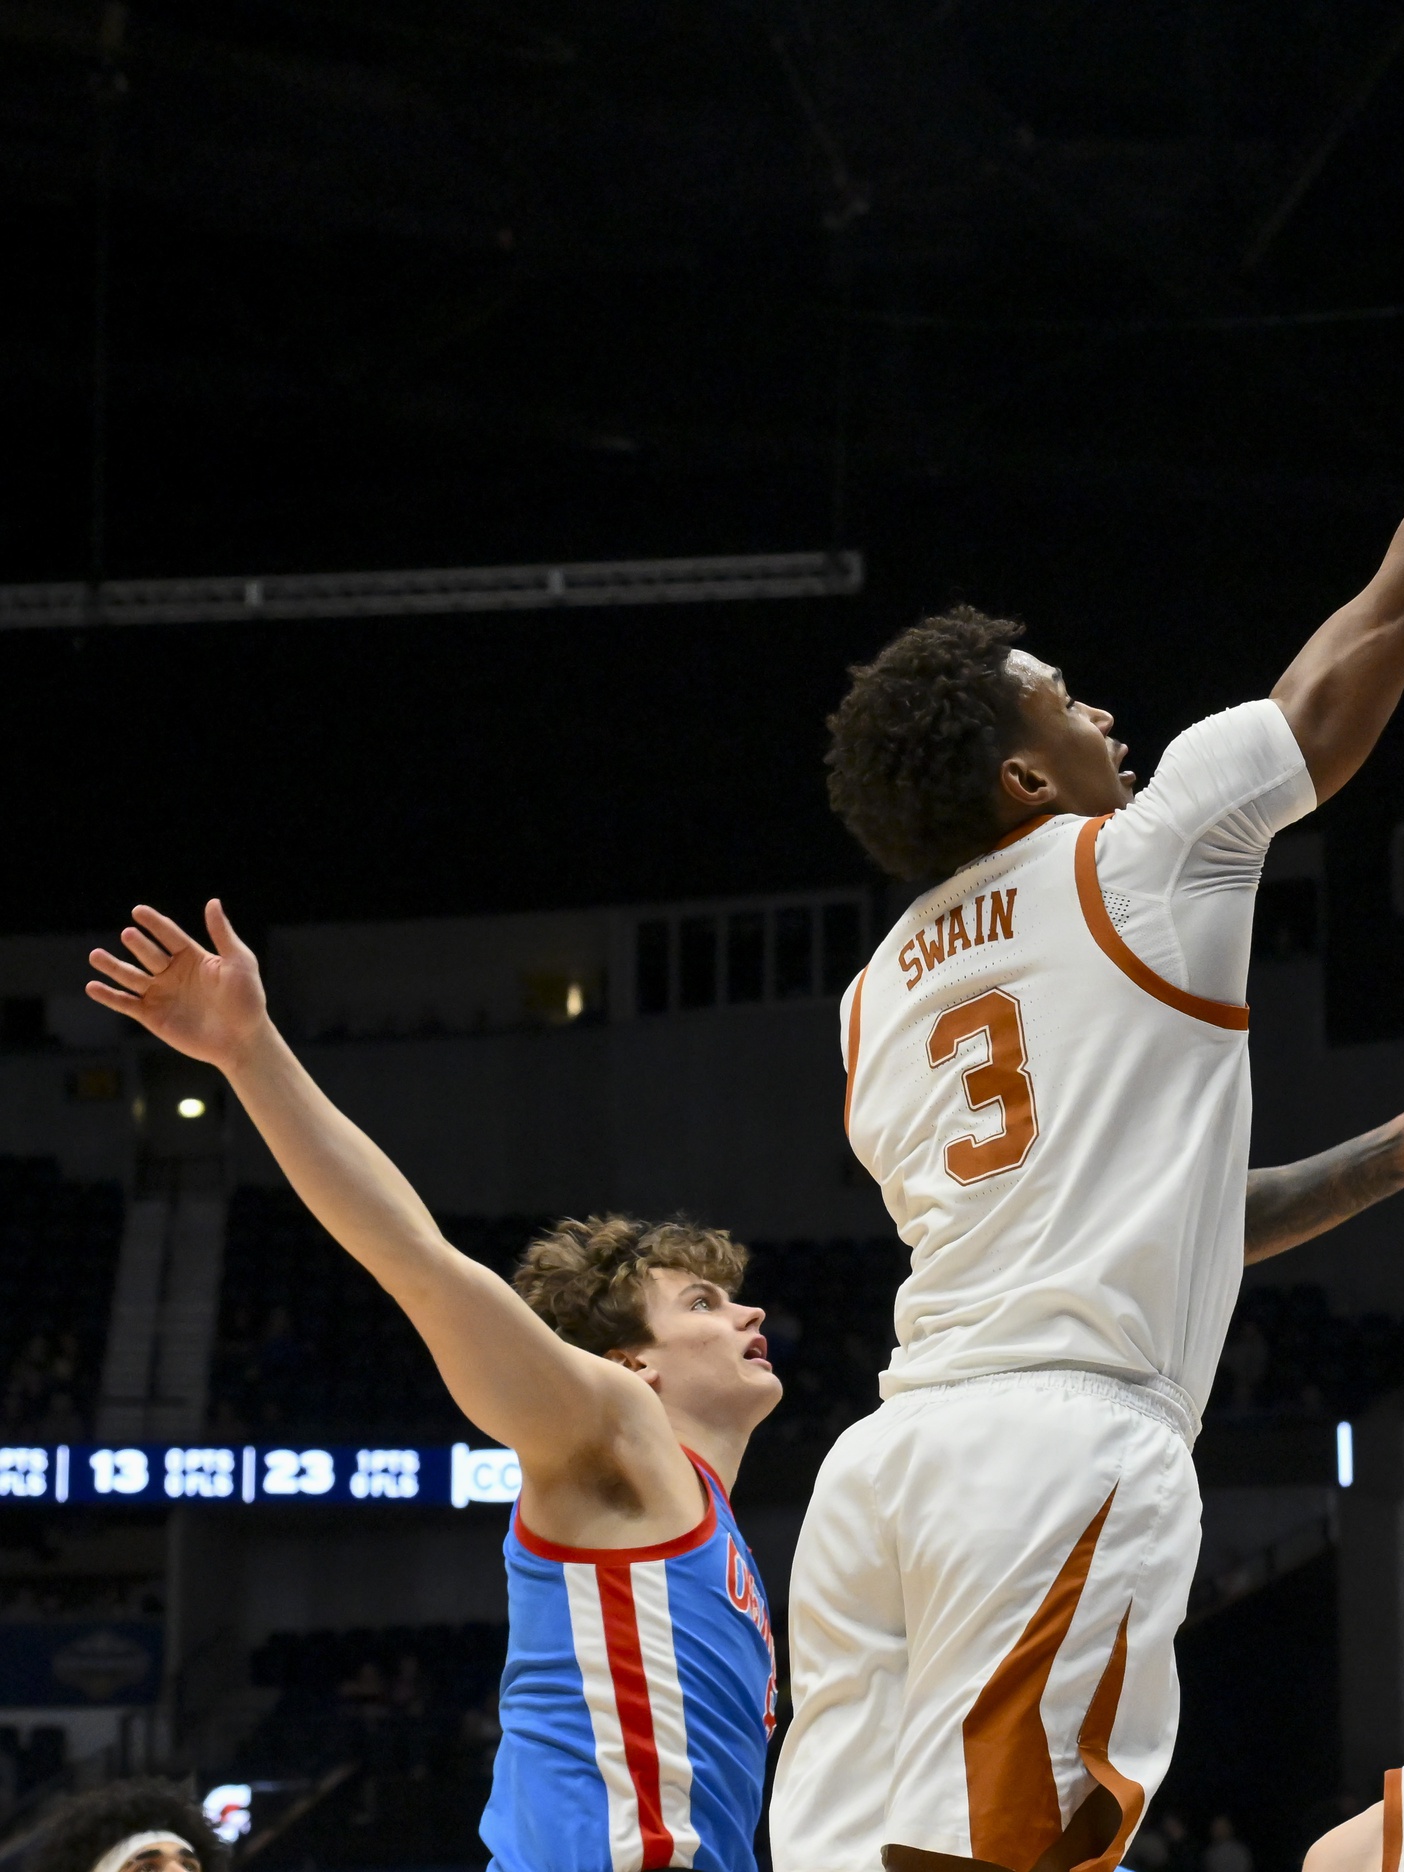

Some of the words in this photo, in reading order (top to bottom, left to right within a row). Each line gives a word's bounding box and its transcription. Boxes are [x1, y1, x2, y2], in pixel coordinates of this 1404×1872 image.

[898, 888, 1017, 991] SWAIN
[925, 986, 1039, 1186] 3
[90, 1449, 149, 1493] 13
[263, 1449, 335, 1494] 23
